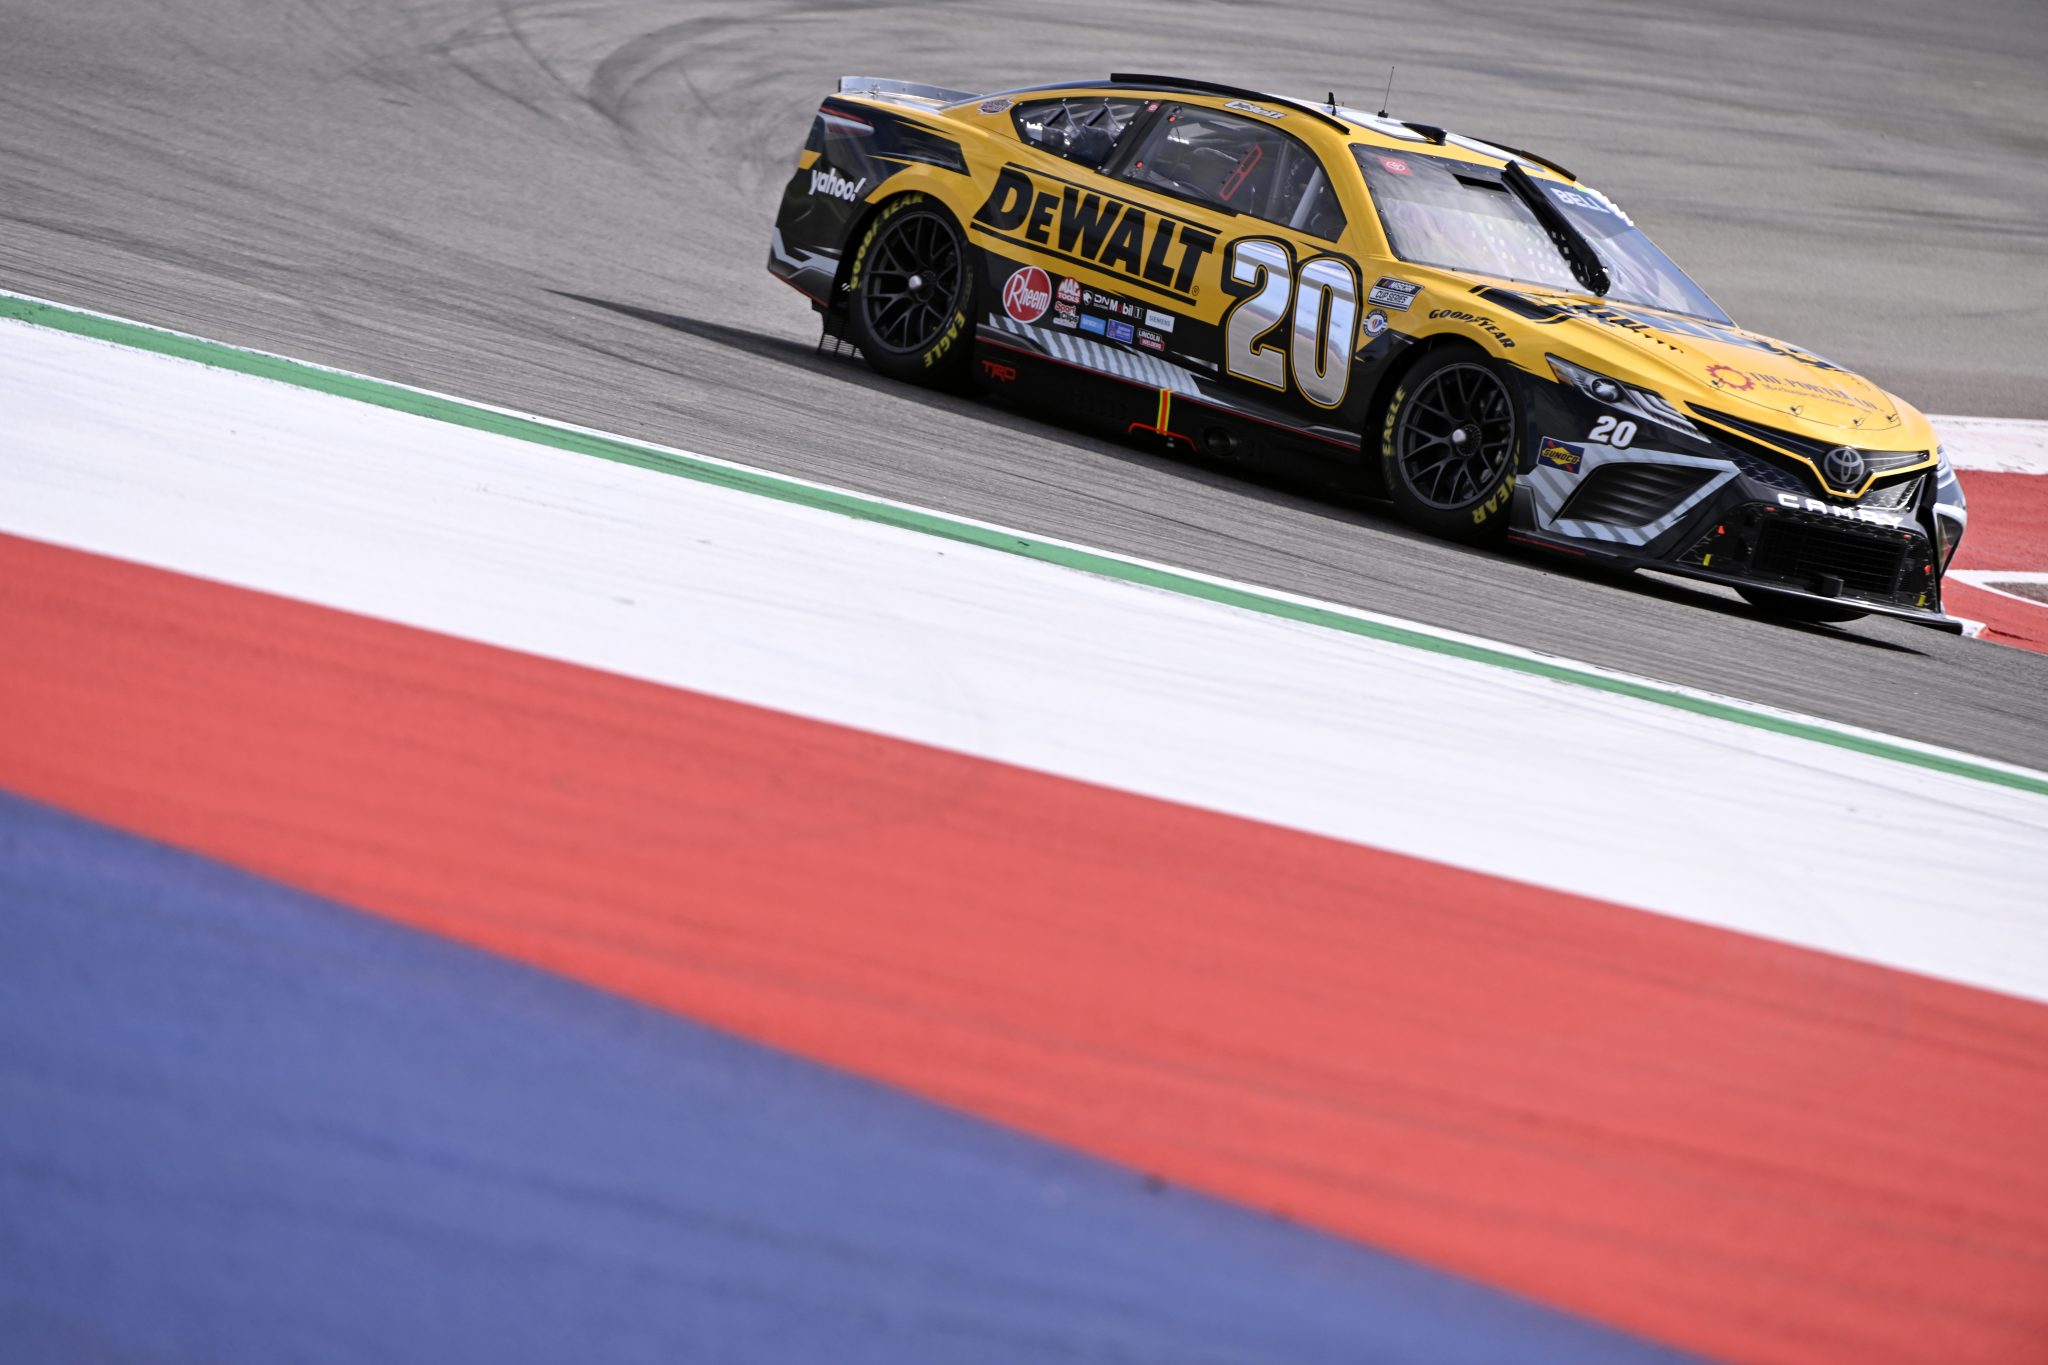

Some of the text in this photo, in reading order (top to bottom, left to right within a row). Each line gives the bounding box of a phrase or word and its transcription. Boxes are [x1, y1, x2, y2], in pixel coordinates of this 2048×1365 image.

[808, 167, 867, 202] yahoo!
[1550, 187, 1611, 214] BELL
[1007, 268, 1048, 312] Rheem
[1057, 291, 1080, 303] TOOLS
[1058, 278, 1080, 297] MAC
[1375, 289, 1389, 299] CUP
[1055, 301, 1077, 314] Sport
[1061, 311, 1079, 323] Clips
[1109, 299, 1134, 317] Mobil
[1225, 239, 1358, 408] 20
[1429, 309, 1516, 348] GOODYEAR
[924, 310, 965, 367] EAGLE
[1138, 330, 1161, 342] LINCOLN
[982, 360, 1016, 381] TRD
[1382, 385, 1406, 457] EAGLE
[1588, 415, 1638, 447] 20
[1543, 449, 1579, 464] SUNOCO
[1777, 493, 1903, 529] CAMRY
